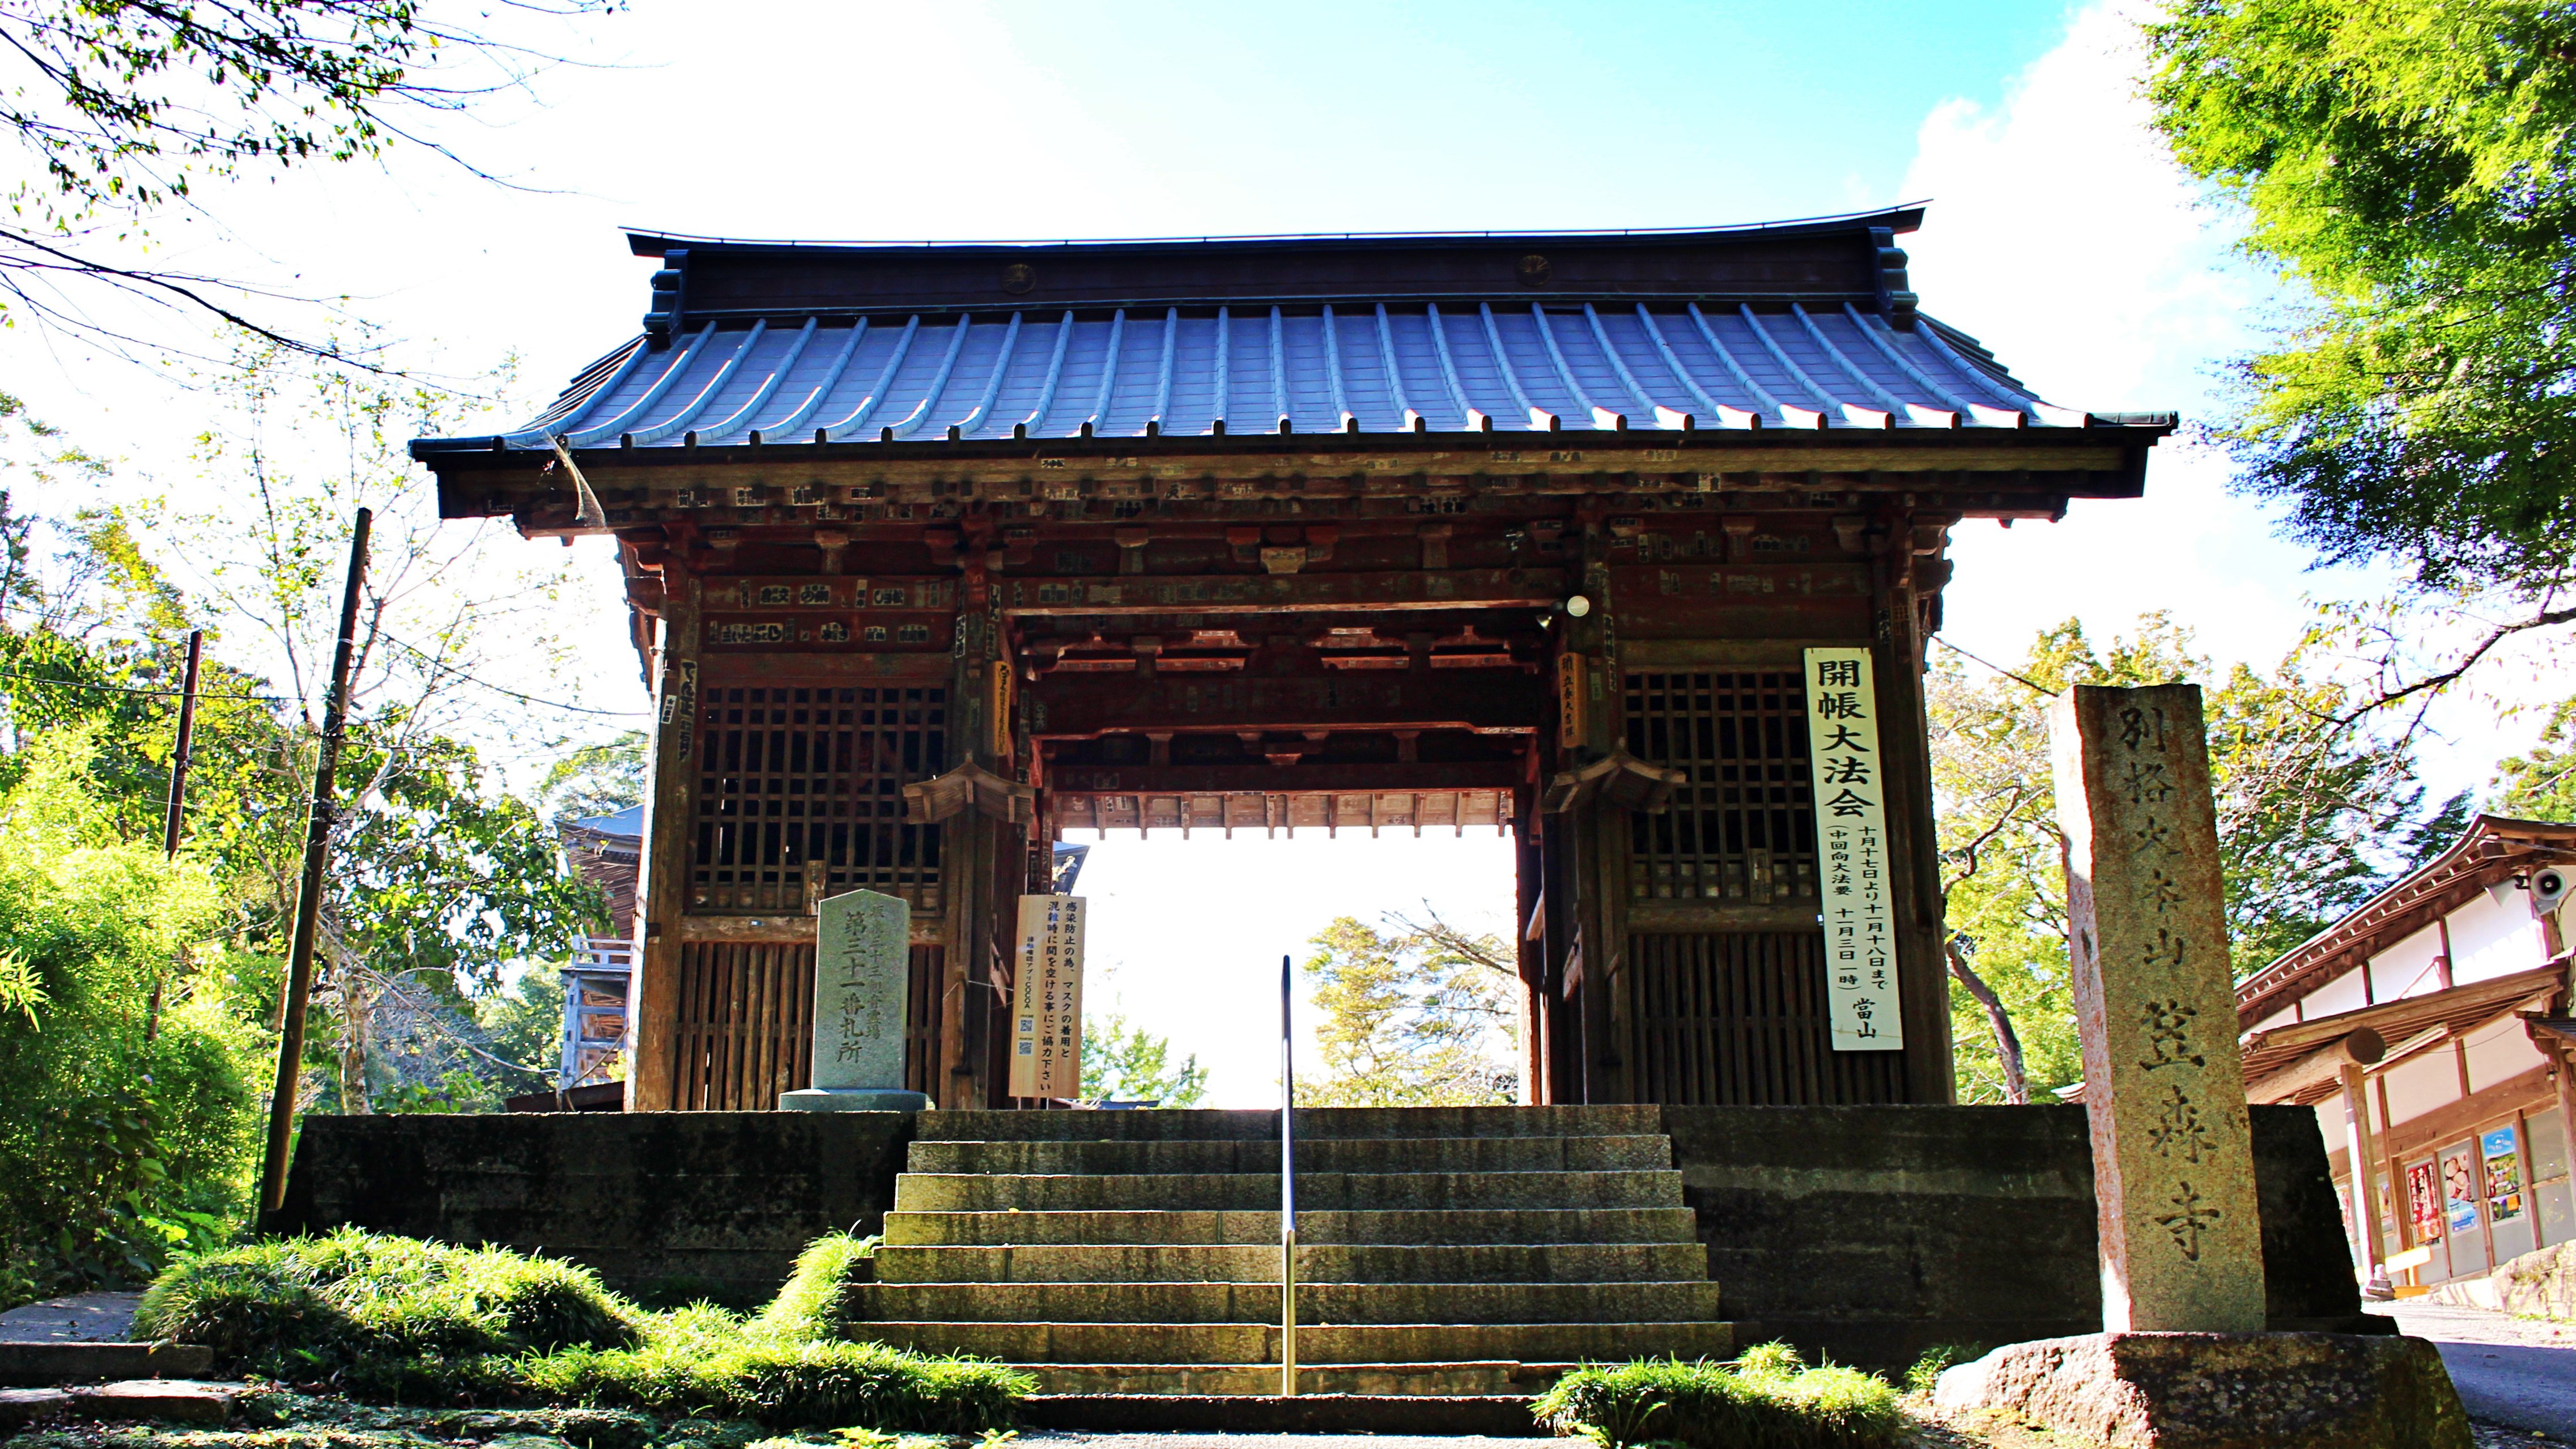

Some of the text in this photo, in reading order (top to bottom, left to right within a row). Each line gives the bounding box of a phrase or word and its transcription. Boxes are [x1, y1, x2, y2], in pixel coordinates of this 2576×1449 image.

[1816, 660, 1876, 818] 開帳大法会
[1857, 826, 1889, 990] 十月十七日より十一月十八日まで
[836, 910, 867, 1064] 第三十一番札所
[1852, 997, 1877, 1039] 當山
